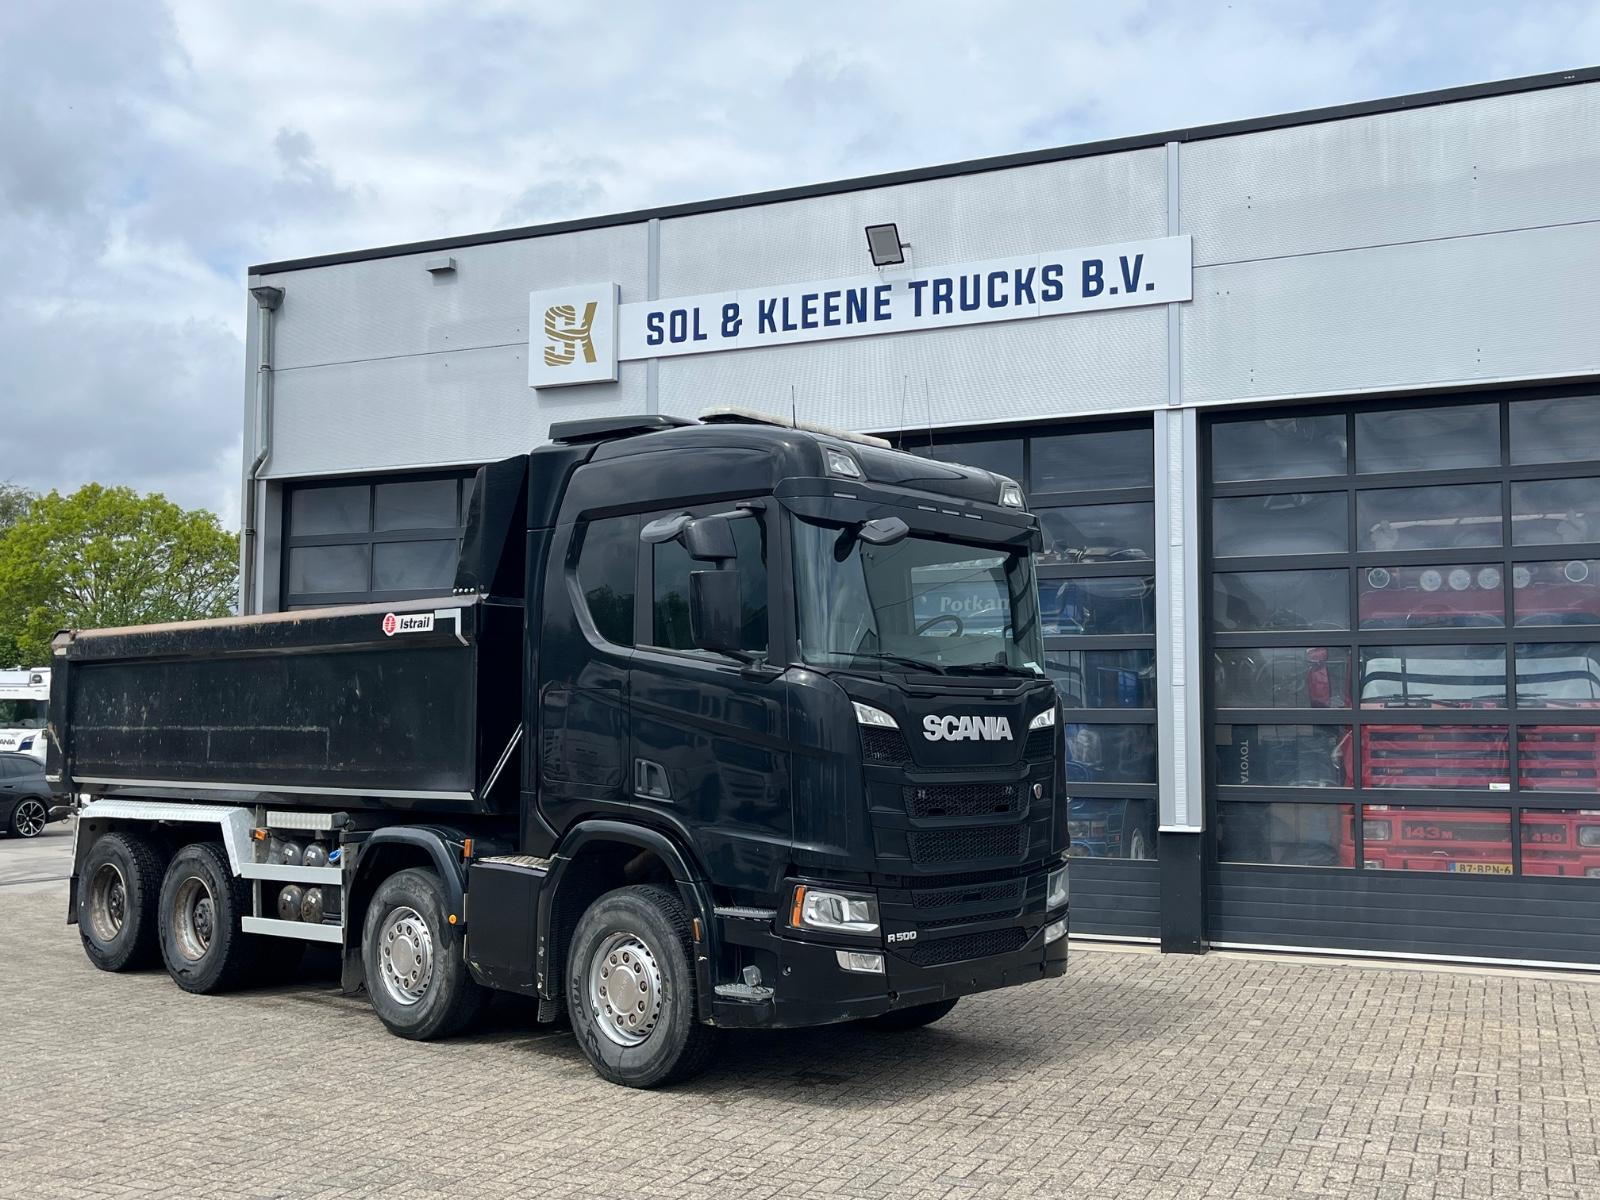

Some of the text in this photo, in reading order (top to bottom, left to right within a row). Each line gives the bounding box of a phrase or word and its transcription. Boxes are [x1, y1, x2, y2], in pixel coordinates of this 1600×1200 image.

[646, 254, 1155, 346] SOL & KLEENE TRUCKS B.V.
[543, 301, 598, 367] SK
[399, 616, 430, 630] Istrail
[922, 714, 1014, 741] SCANIA
[1240, 739, 1249, 784] TOYOTA
[887, 930, 917, 943] R 500
